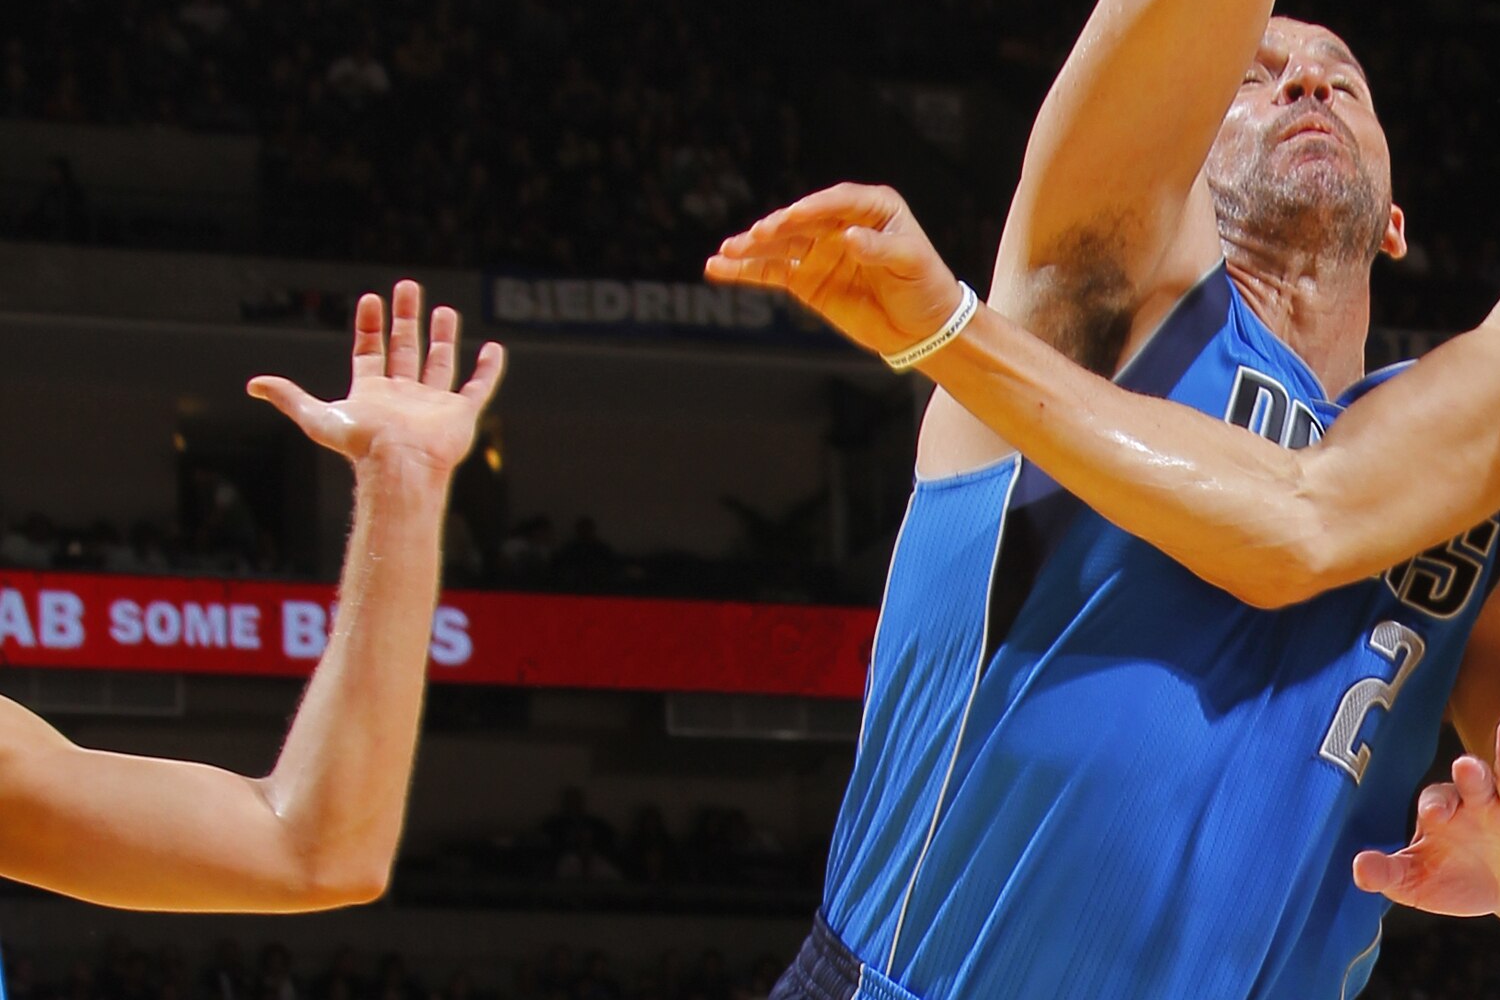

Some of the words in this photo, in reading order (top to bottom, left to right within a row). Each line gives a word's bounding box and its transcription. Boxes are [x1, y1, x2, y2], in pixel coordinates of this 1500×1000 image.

[109, 599, 262, 650] SOME
[281, 600, 473, 666] BS
[1318, 619, 1426, 787] 2
